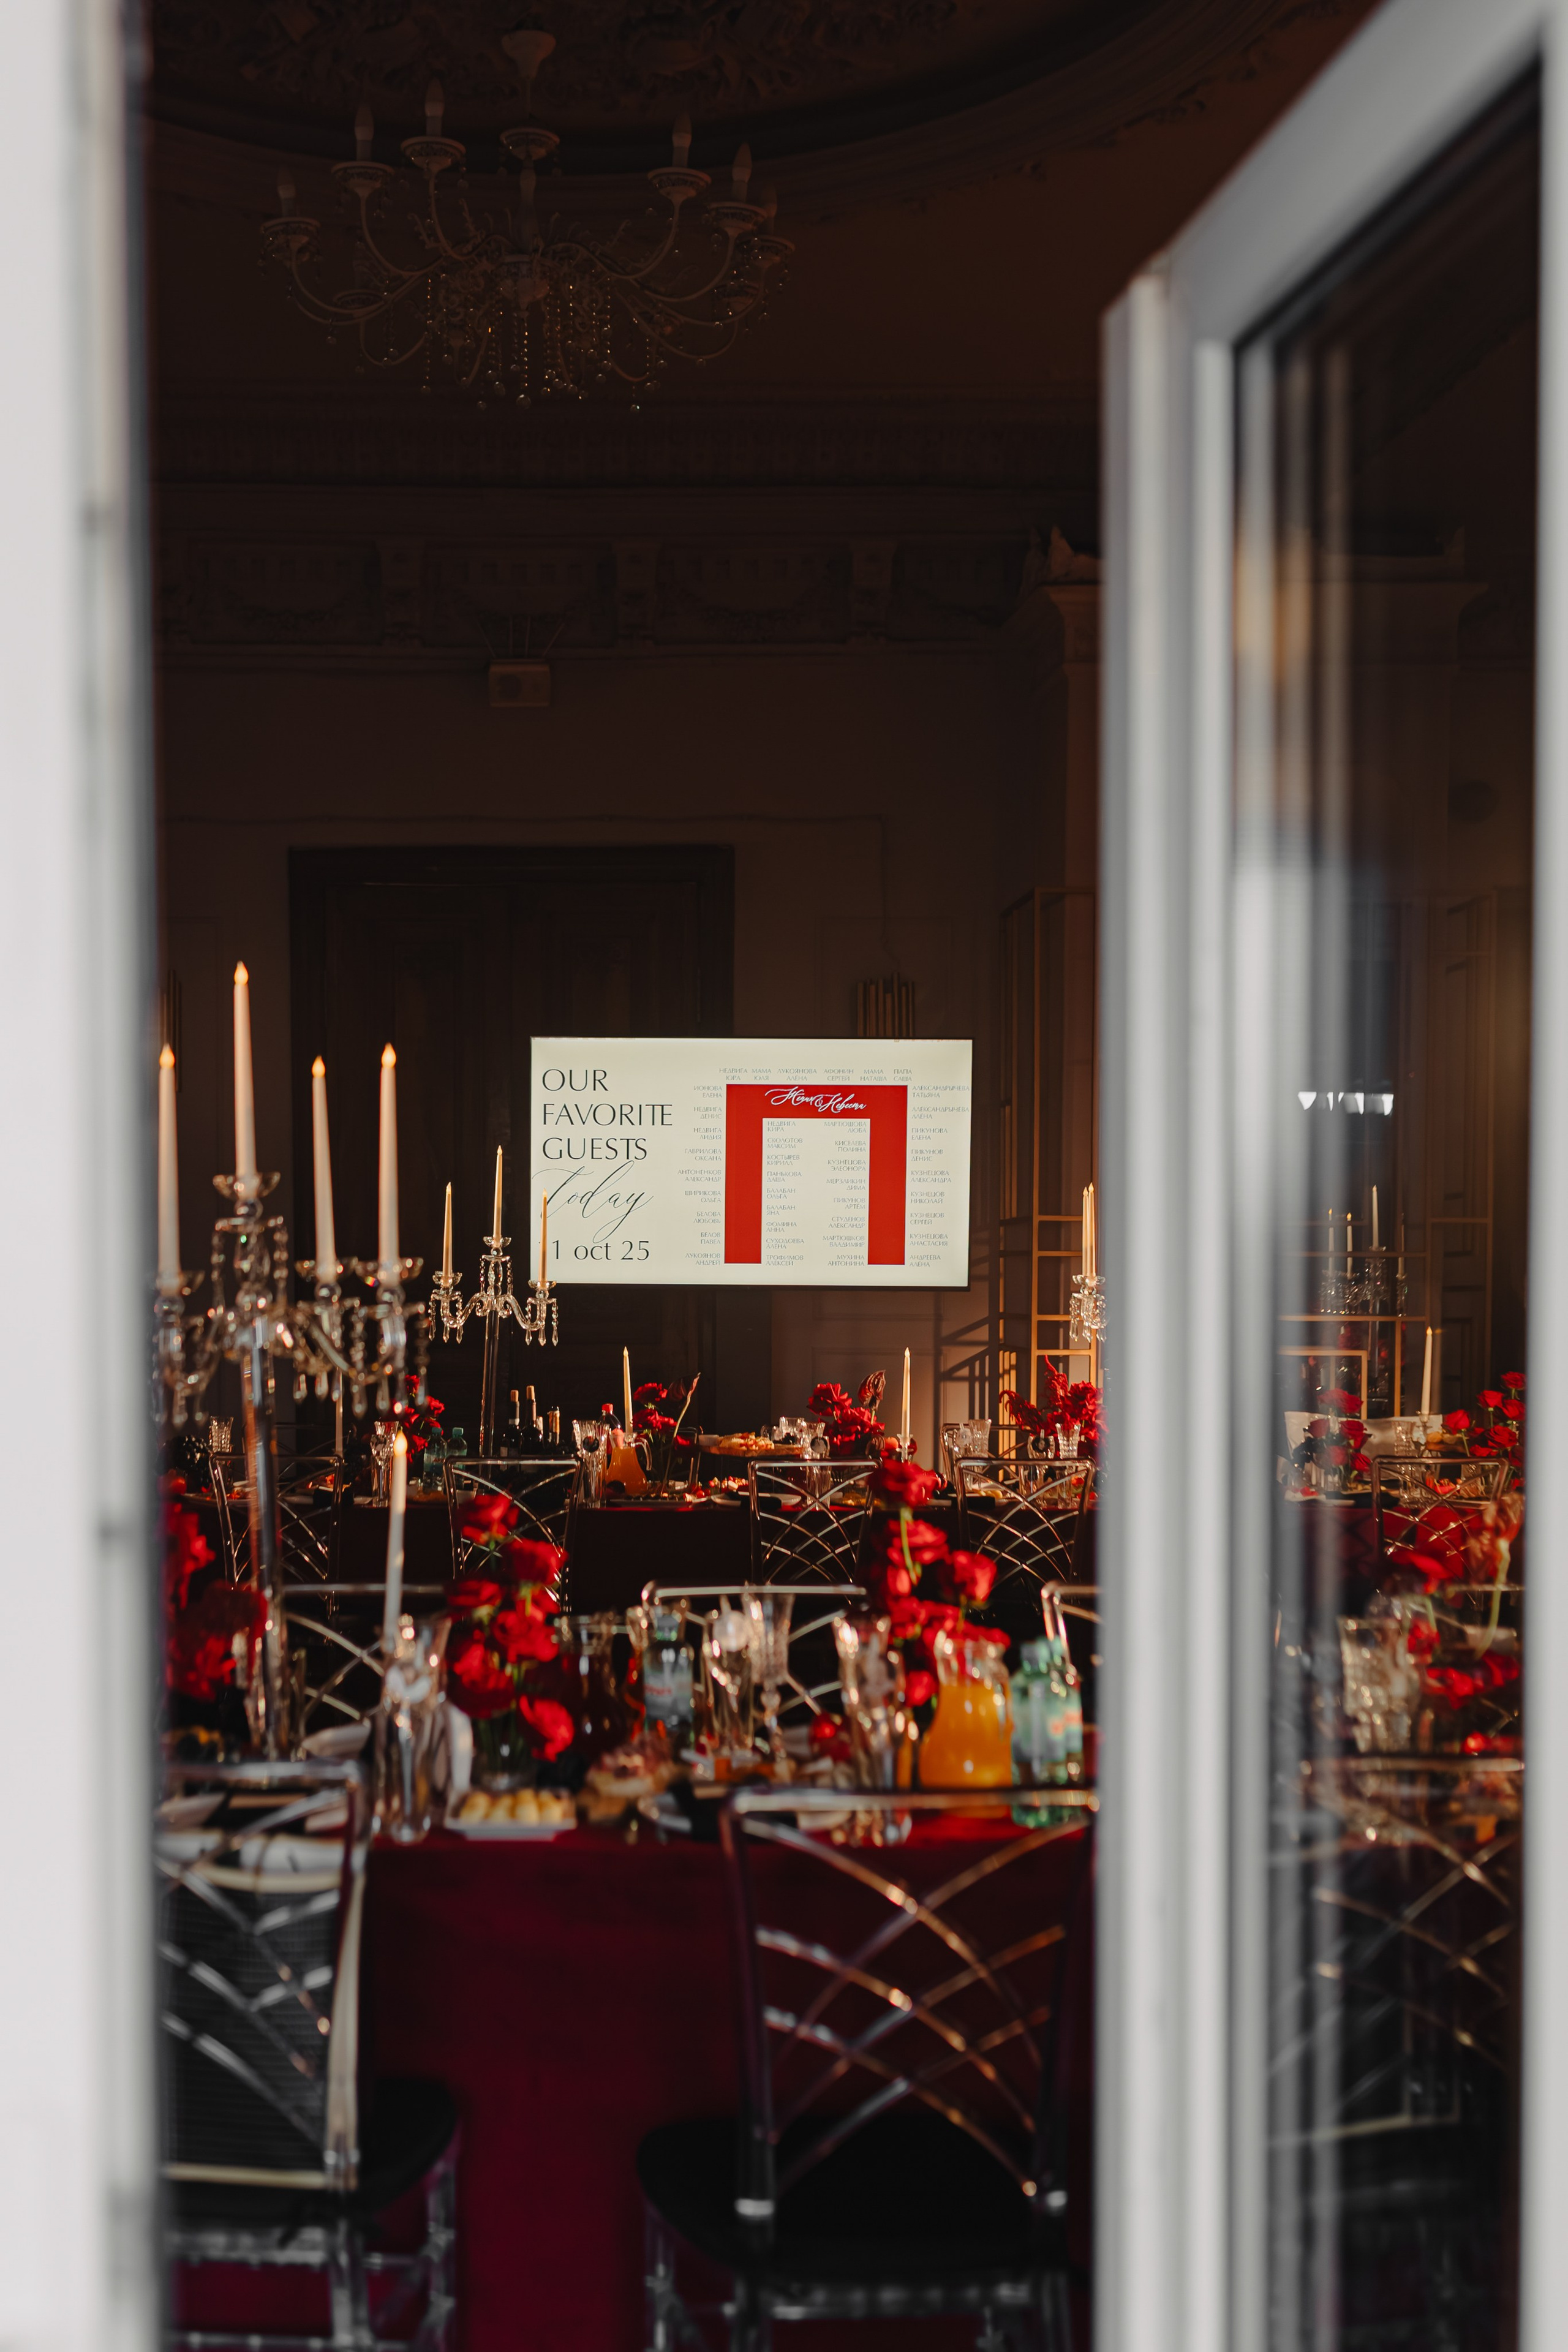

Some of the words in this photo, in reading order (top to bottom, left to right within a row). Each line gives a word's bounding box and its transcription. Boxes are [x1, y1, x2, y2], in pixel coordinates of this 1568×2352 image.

[542, 1068, 609, 1091] OUR
[765, 1086, 813, 1106] Жених
[818, 1093, 867, 1114] Невеста
[543, 1103, 673, 1126] FAVORITE
[542, 1137, 647, 1160] GUESTS
[532, 1160, 654, 1243] Today
[538, 1240, 559, 1260] 1
[574, 1242, 611, 1261] oct
[620, 1240, 649, 1261] 25
